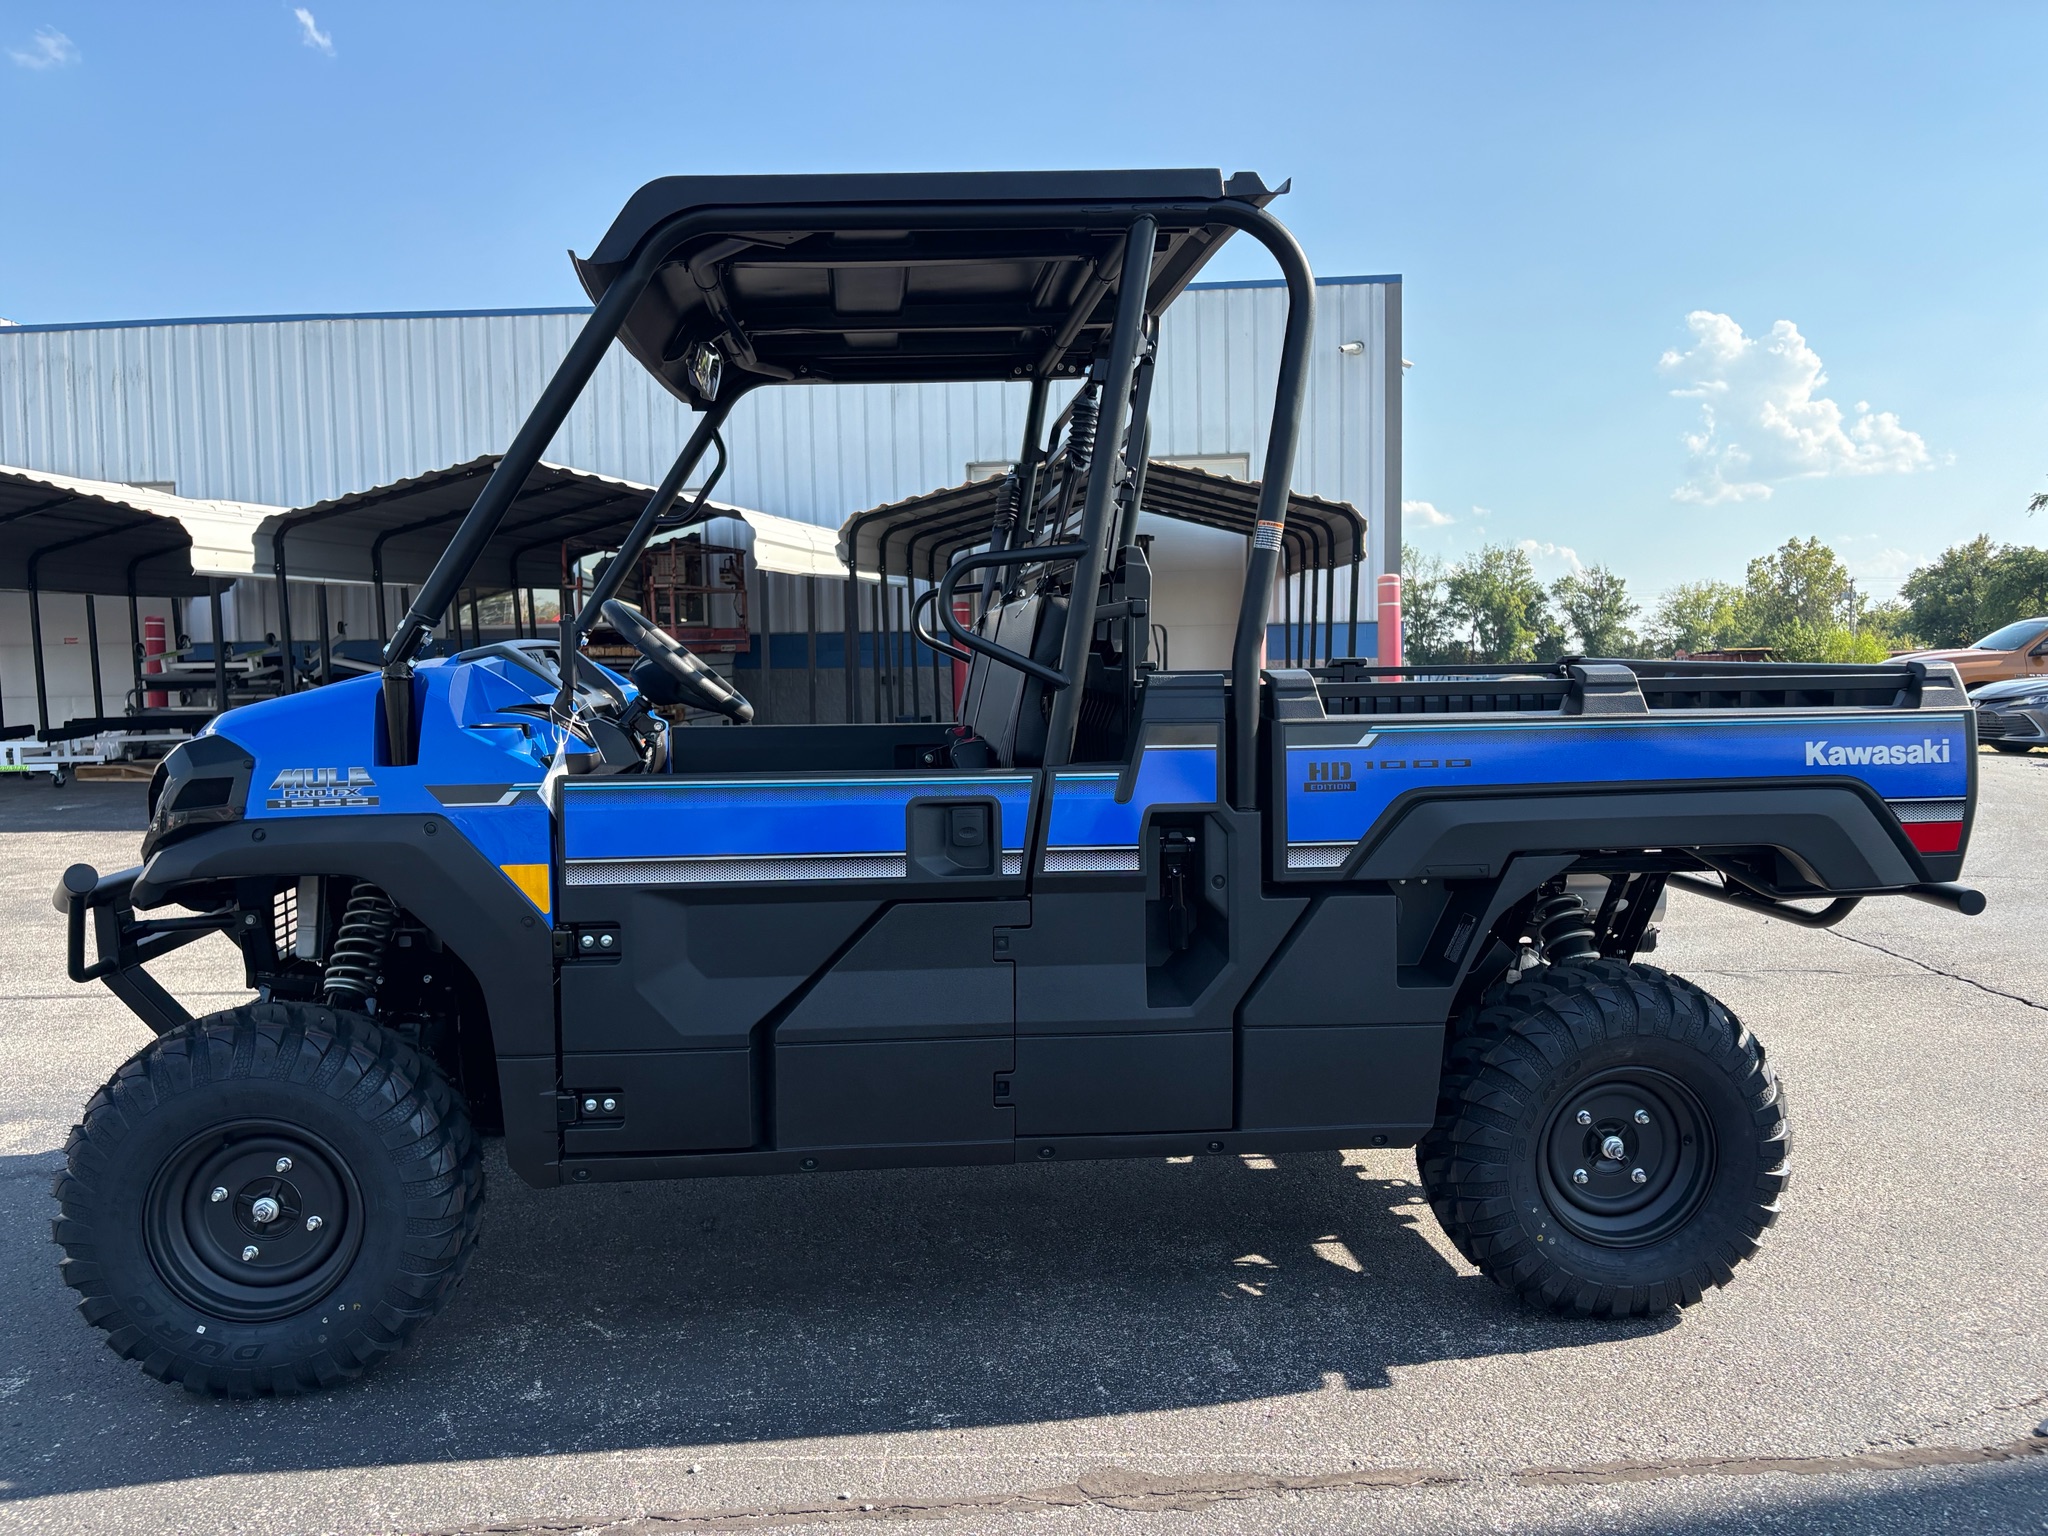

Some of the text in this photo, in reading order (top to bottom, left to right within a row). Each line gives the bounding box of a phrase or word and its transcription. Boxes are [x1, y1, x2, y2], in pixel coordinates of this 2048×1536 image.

[1805, 738, 1949, 766] Kawasaki
[1308, 762, 1352, 781] HD
[1364, 759, 1471, 769] 1000
[269, 767, 377, 790] MULE
[1309, 783, 1351, 791] EDITION
[278, 798, 369, 809] 1000
[127, 1295, 266, 1361] DURO
